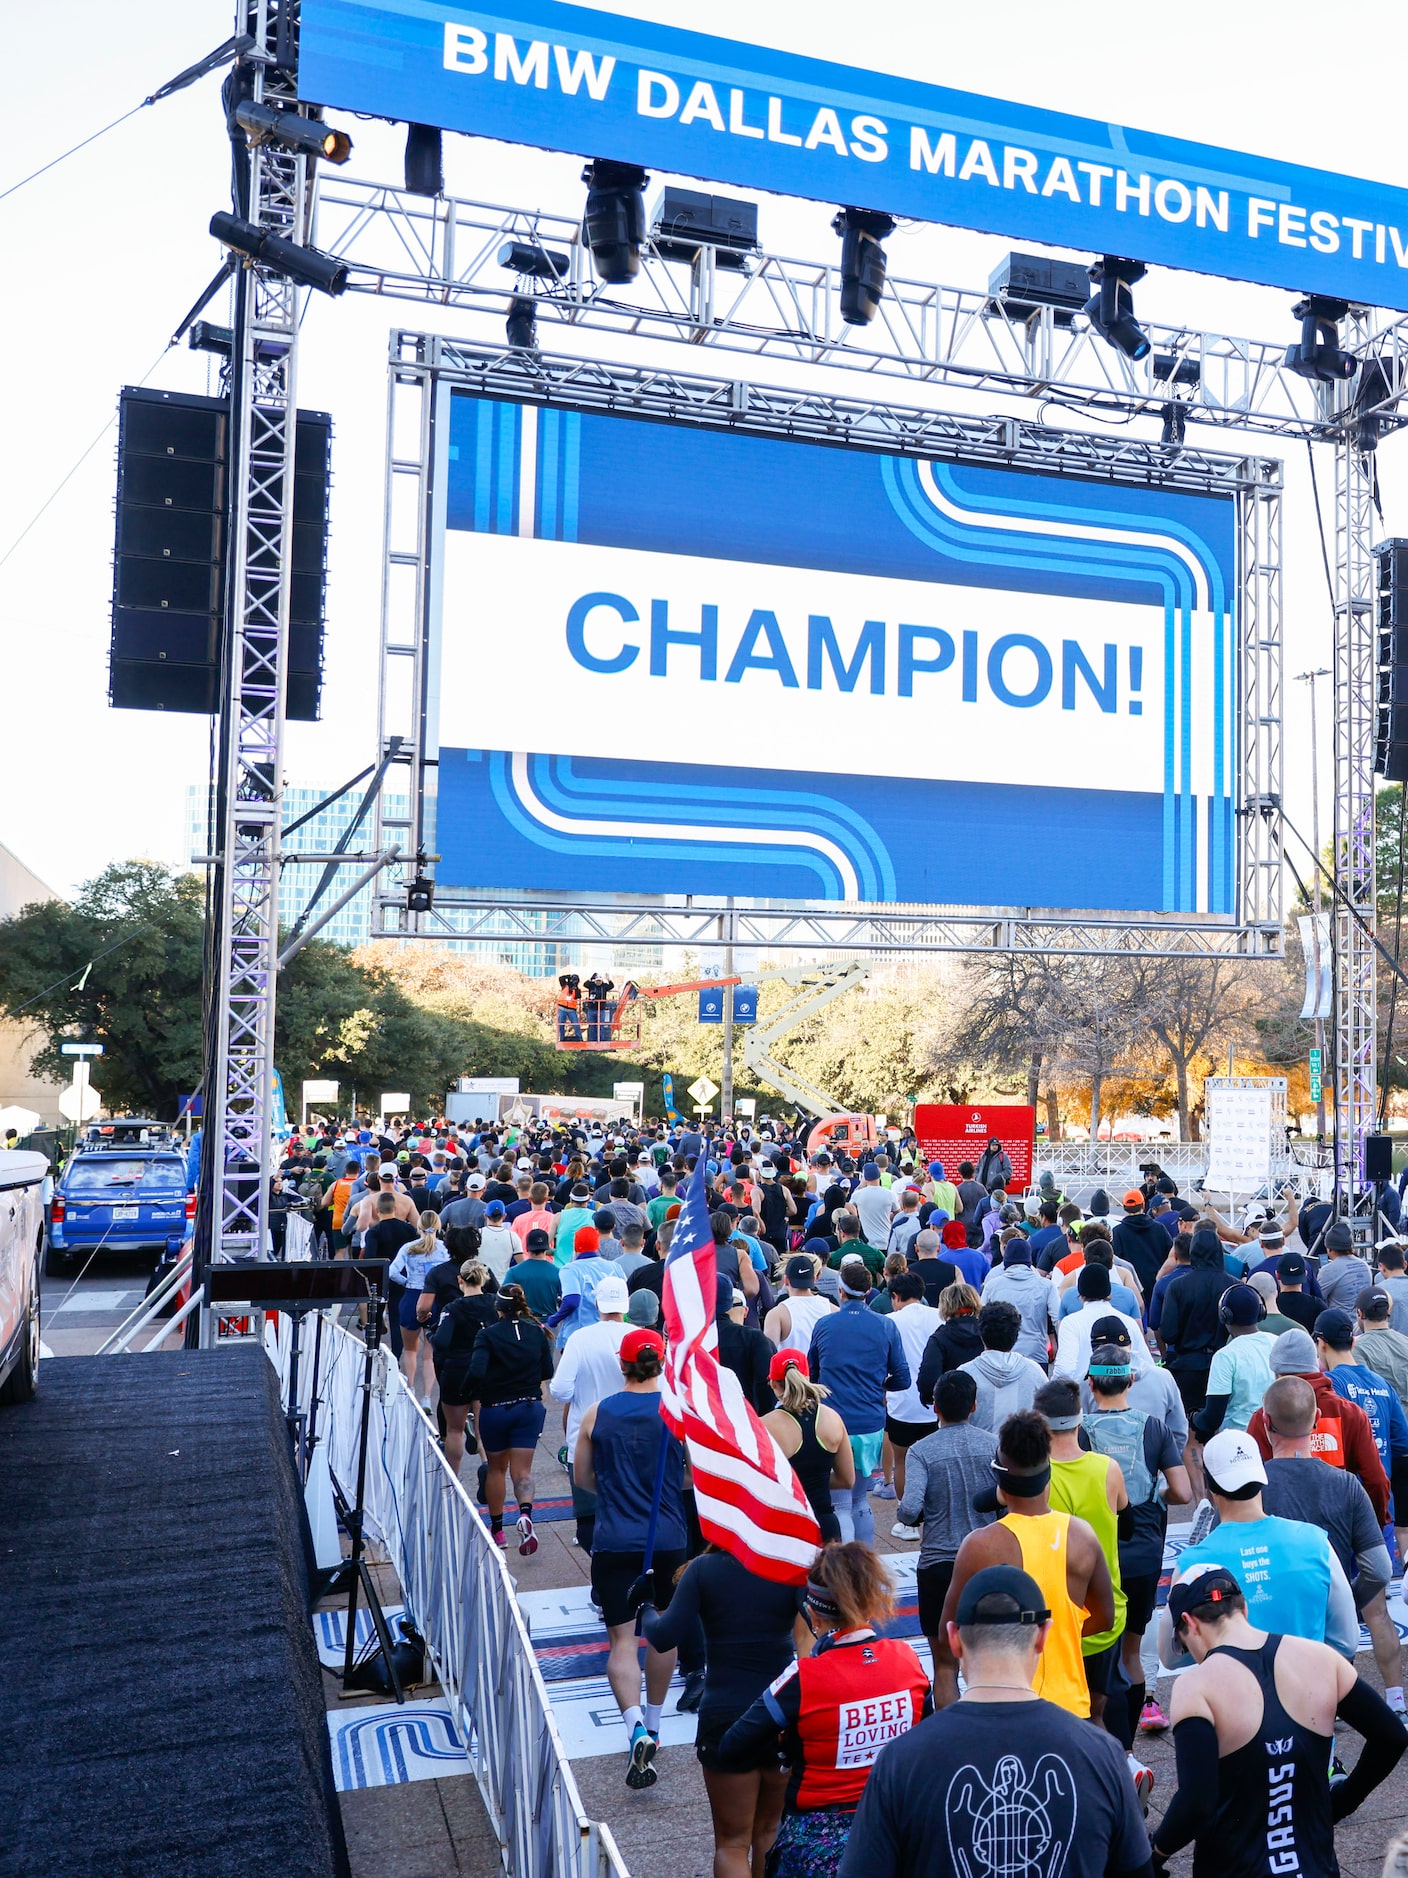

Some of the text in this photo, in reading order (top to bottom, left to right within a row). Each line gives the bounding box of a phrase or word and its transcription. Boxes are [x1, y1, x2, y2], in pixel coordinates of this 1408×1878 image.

[443, 20, 616, 102] BMW
[636, 68, 889, 164] DALLAS
[909, 126, 1229, 233] MARATHON
[565, 591, 1143, 716] CHAMPION!
[1240, 1546, 1255, 1557] Last
[1242, 1557, 1270, 1569] buys the
[1245, 1570, 1272, 1584] SHOTS.
[845, 1697, 907, 1730] BEEF
[844, 1721, 908, 1748] LOVING
[1266, 1763, 1303, 1878] GASUS
